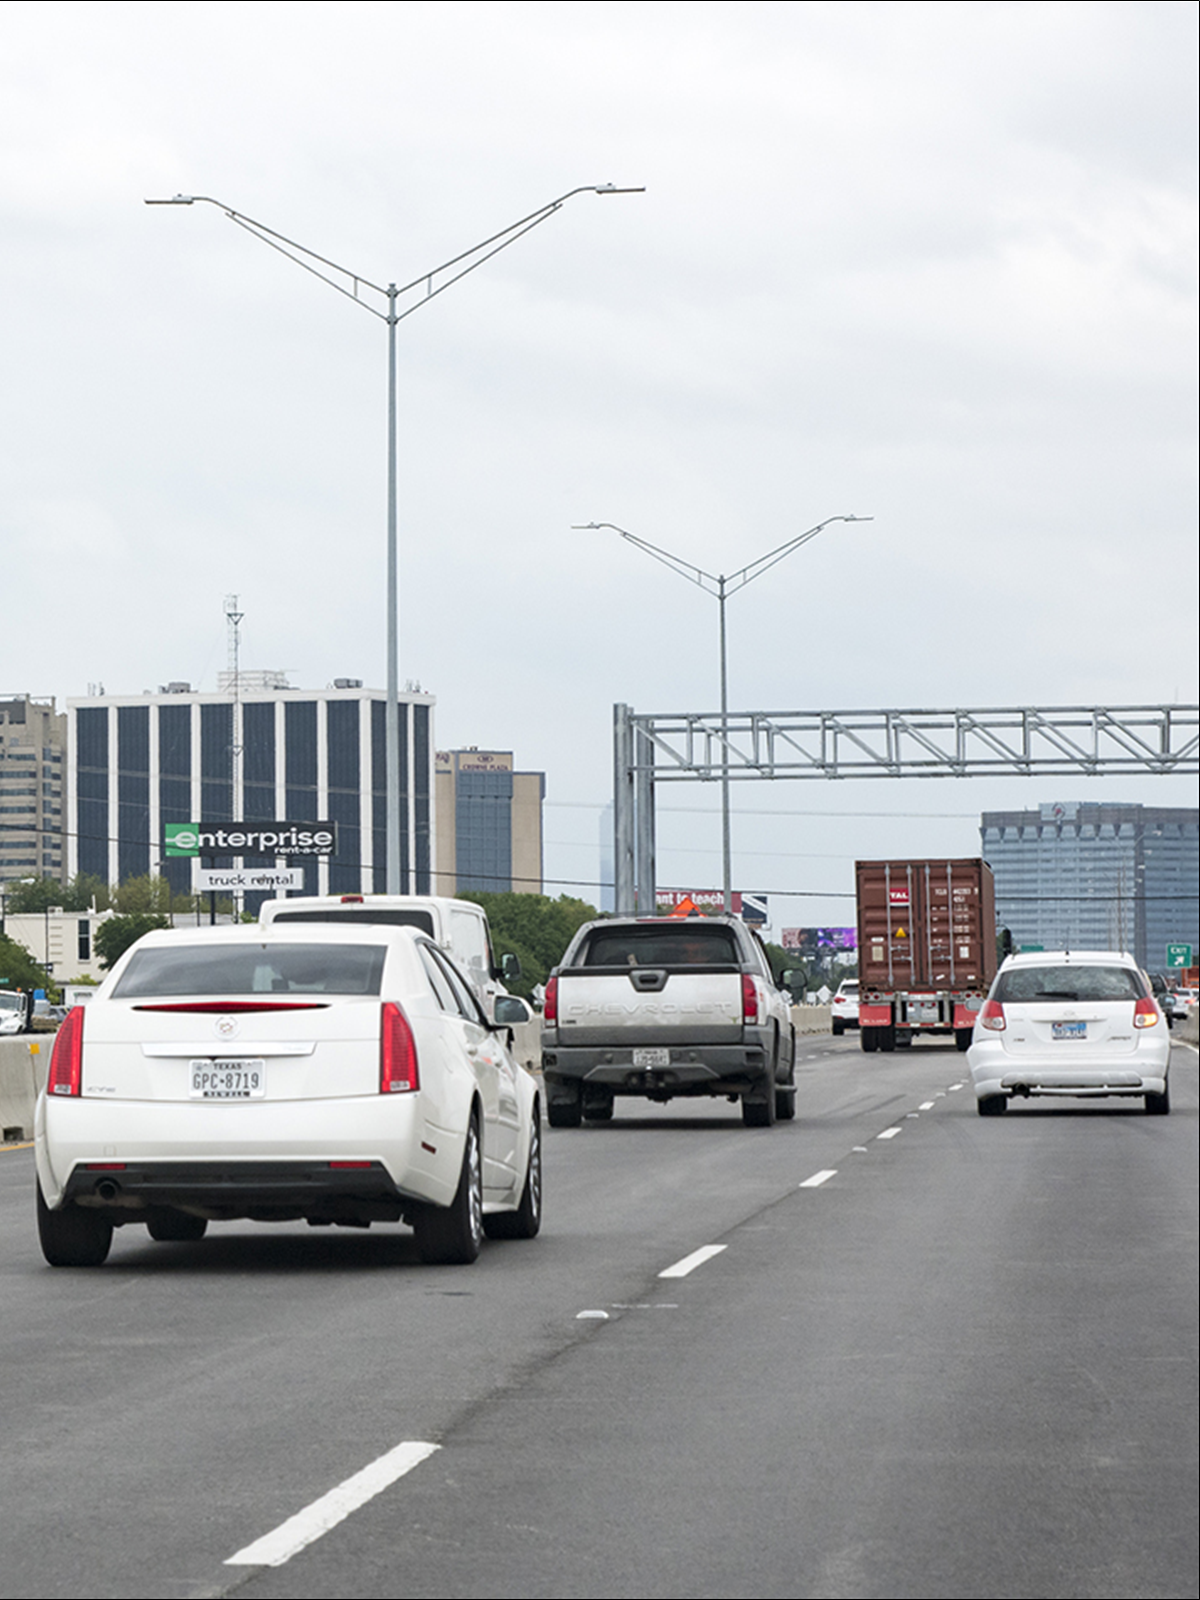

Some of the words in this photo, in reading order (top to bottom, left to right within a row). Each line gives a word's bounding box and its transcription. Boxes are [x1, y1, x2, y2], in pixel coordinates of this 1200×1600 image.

[173, 826, 333, 852] enterprise
[274, 846, 333, 854] rent-a-car
[208, 874, 246, 886] truck
[251, 873, 294, 886] rental
[656, 893, 674, 905] ant
[691, 892, 724, 905] teach
[1170, 946, 1187, 954] EXIT
[566, 1001, 733, 1017] CHEVROLET
[213, 1062, 242, 1070] TEXAS
